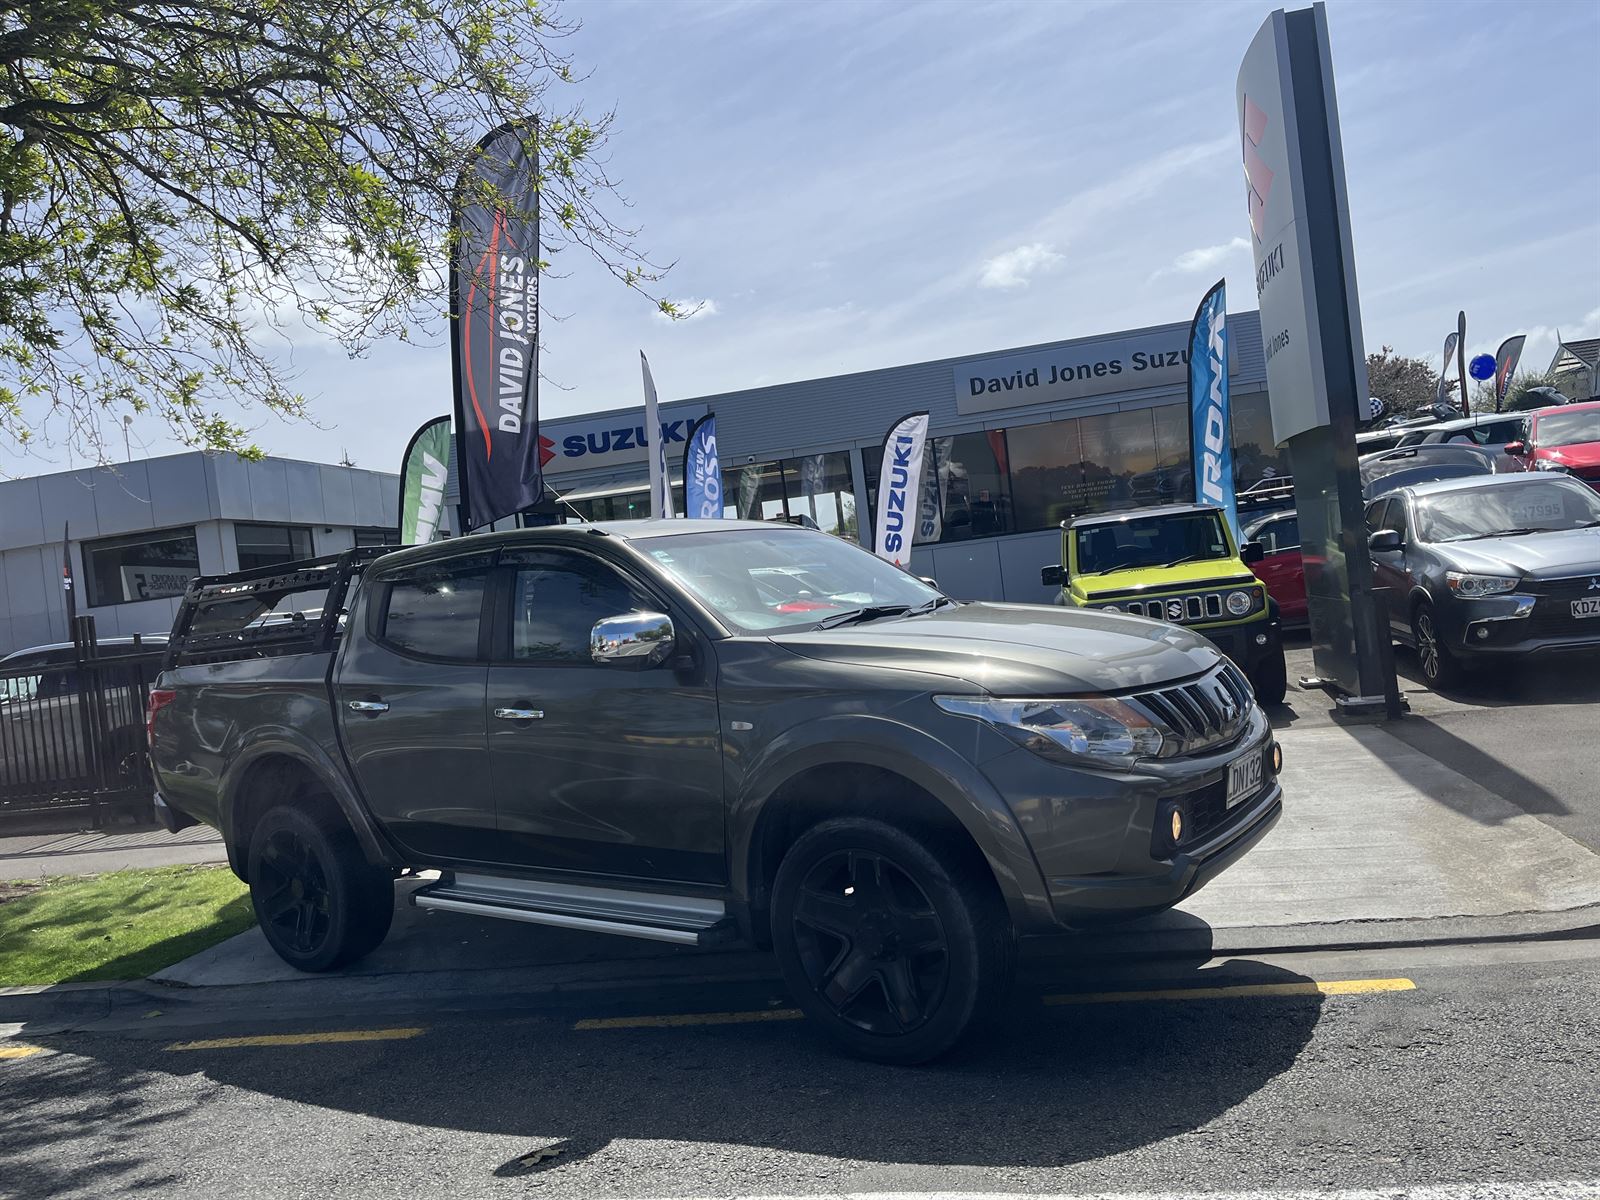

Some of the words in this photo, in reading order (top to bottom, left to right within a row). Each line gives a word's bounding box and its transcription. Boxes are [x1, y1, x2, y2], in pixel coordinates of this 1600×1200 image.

[499, 254, 527, 348] JONES
[527, 275, 539, 335] MOTORS
[498, 346, 525, 434] DAVID
[970, 368, 1039, 396] David
[1048, 355, 1122, 384] Jones
[1202, 308, 1225, 504] RONX
[563, 419, 697, 457] SUZUKI
[695, 448, 705, 486] NEW
[885, 436, 913, 553] SUZUKI
